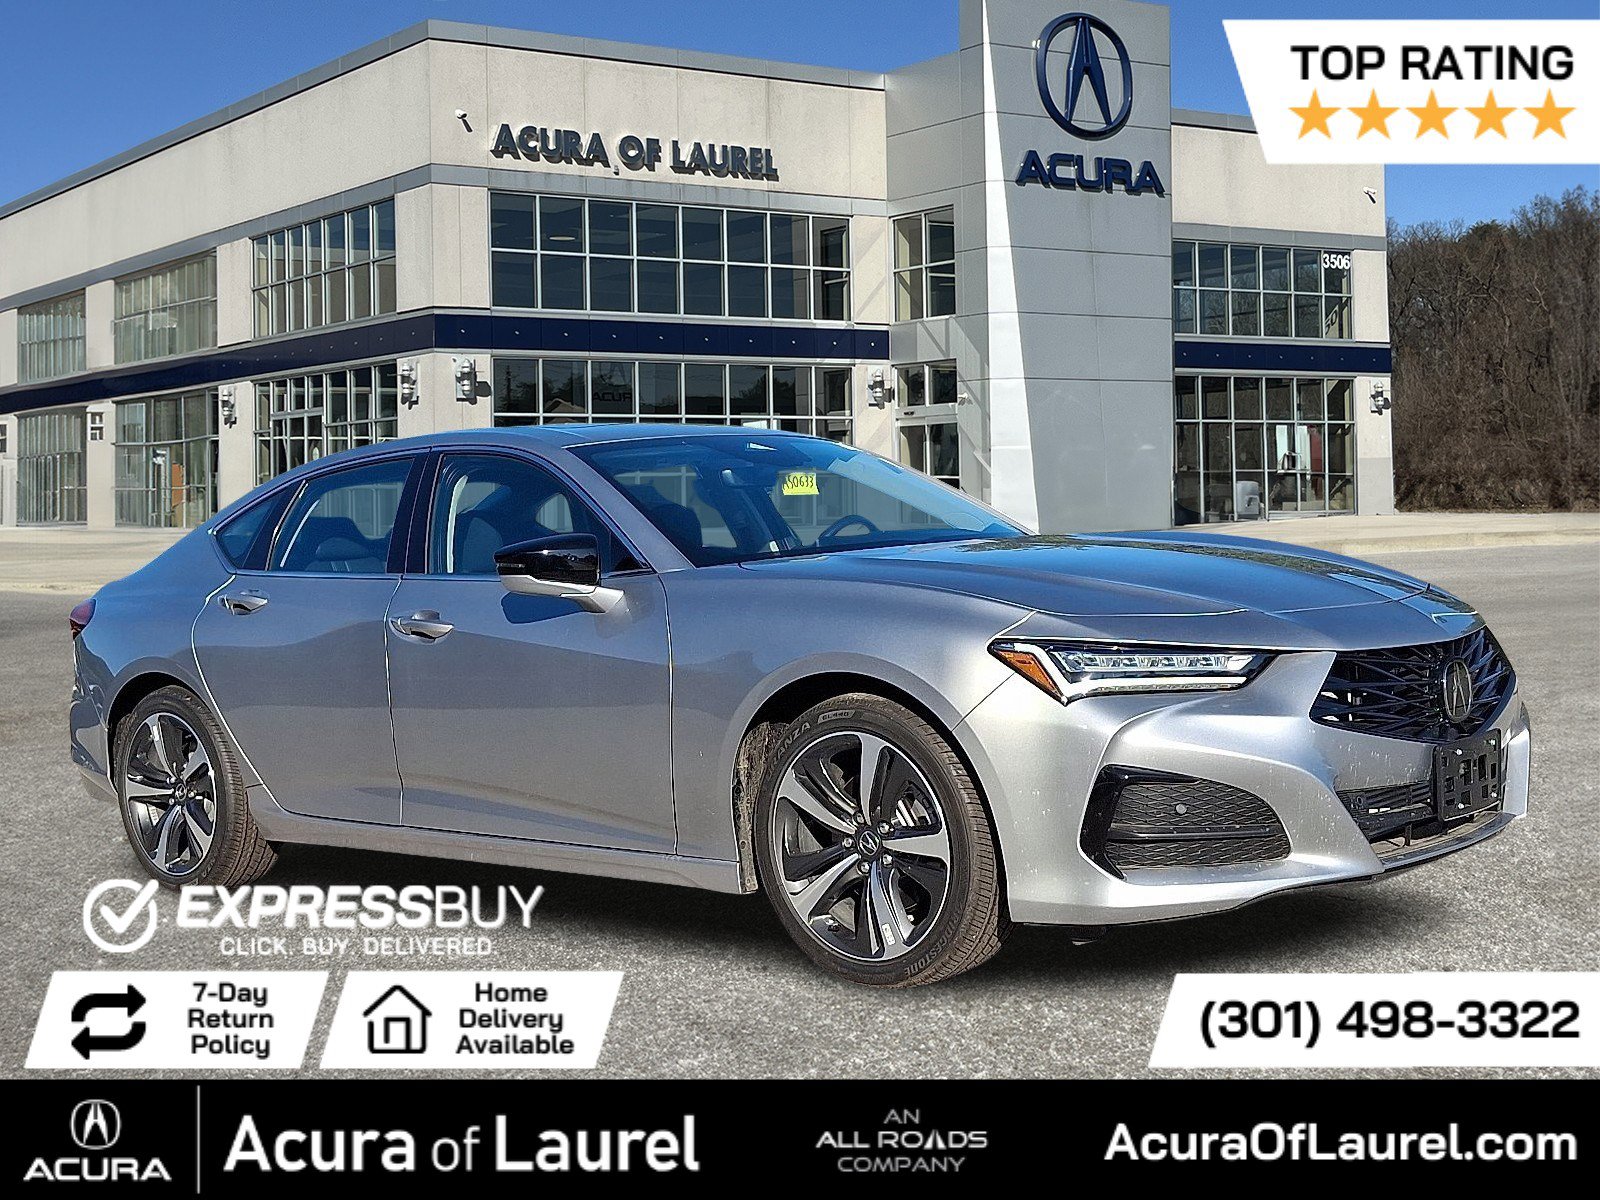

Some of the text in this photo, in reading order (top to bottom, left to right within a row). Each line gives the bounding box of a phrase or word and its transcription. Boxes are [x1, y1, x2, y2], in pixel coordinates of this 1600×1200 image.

[490, 123, 780, 182] ACURA OF LAUREL
[1015, 149, 1166, 199] ACURA
[1322, 253, 1351, 270] 3506
